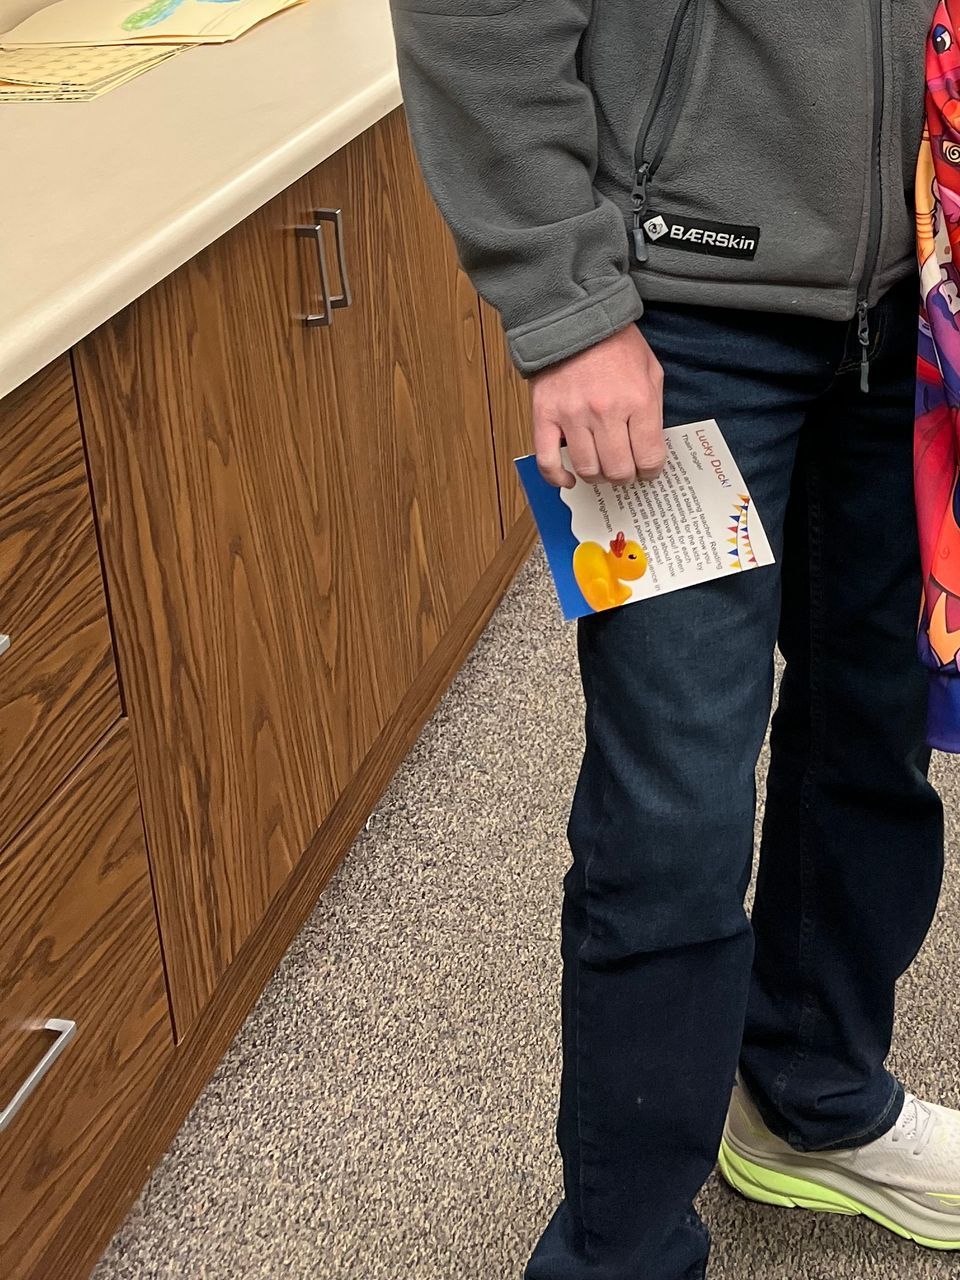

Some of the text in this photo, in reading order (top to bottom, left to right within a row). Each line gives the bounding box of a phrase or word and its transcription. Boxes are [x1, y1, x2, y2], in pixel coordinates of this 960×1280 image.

[681, 433, 704, 470] Thain Segler
[695, 429, 731, 488] Lucky Duck!
[666, 460, 676, 472] with
[657, 479, 666, 492] and
[671, 473, 681, 484] you
[662, 493, 673, 512] funny
[664, 437, 673, 449] You
[670, 450, 678, 460] are
[676, 461, 687, 475] such
[683, 476, 690, 484] an
[687, 485, 702, 512] amazing
[709, 540, 723, 569] Reading
[670, 489, 688, 523] interesting
[597, 497, 614, 532] Wightman
[632, 490, 642, 507] were
[639, 507, 648, 519] still
[644, 528, 656, 544] your
[669, 512, 681, 534] voices
[641, 489, 656, 517] students
[651, 517, 665, 541] talking
[660, 541, 672, 561] about
[667, 562, 676, 576] how
[651, 489, 666, 517] students
[662, 518, 672, 533] love
[674, 554, 684, 572] often
[683, 523, 691, 533] for
[692, 520, 701, 534] love
[626, 501, 637, 517] such
[634, 524, 648, 550] positive
[644, 551, 658, 583] influence
[654, 583, 661, 591] in
[677, 534, 685, 545] for
[687, 534, 696, 545] the
[698, 535, 706, 550] how
[680, 546, 691, 563] each
[691, 546, 701, 561] kids
[701, 551, 711, 564] you
[696, 561, 703, 571] by
